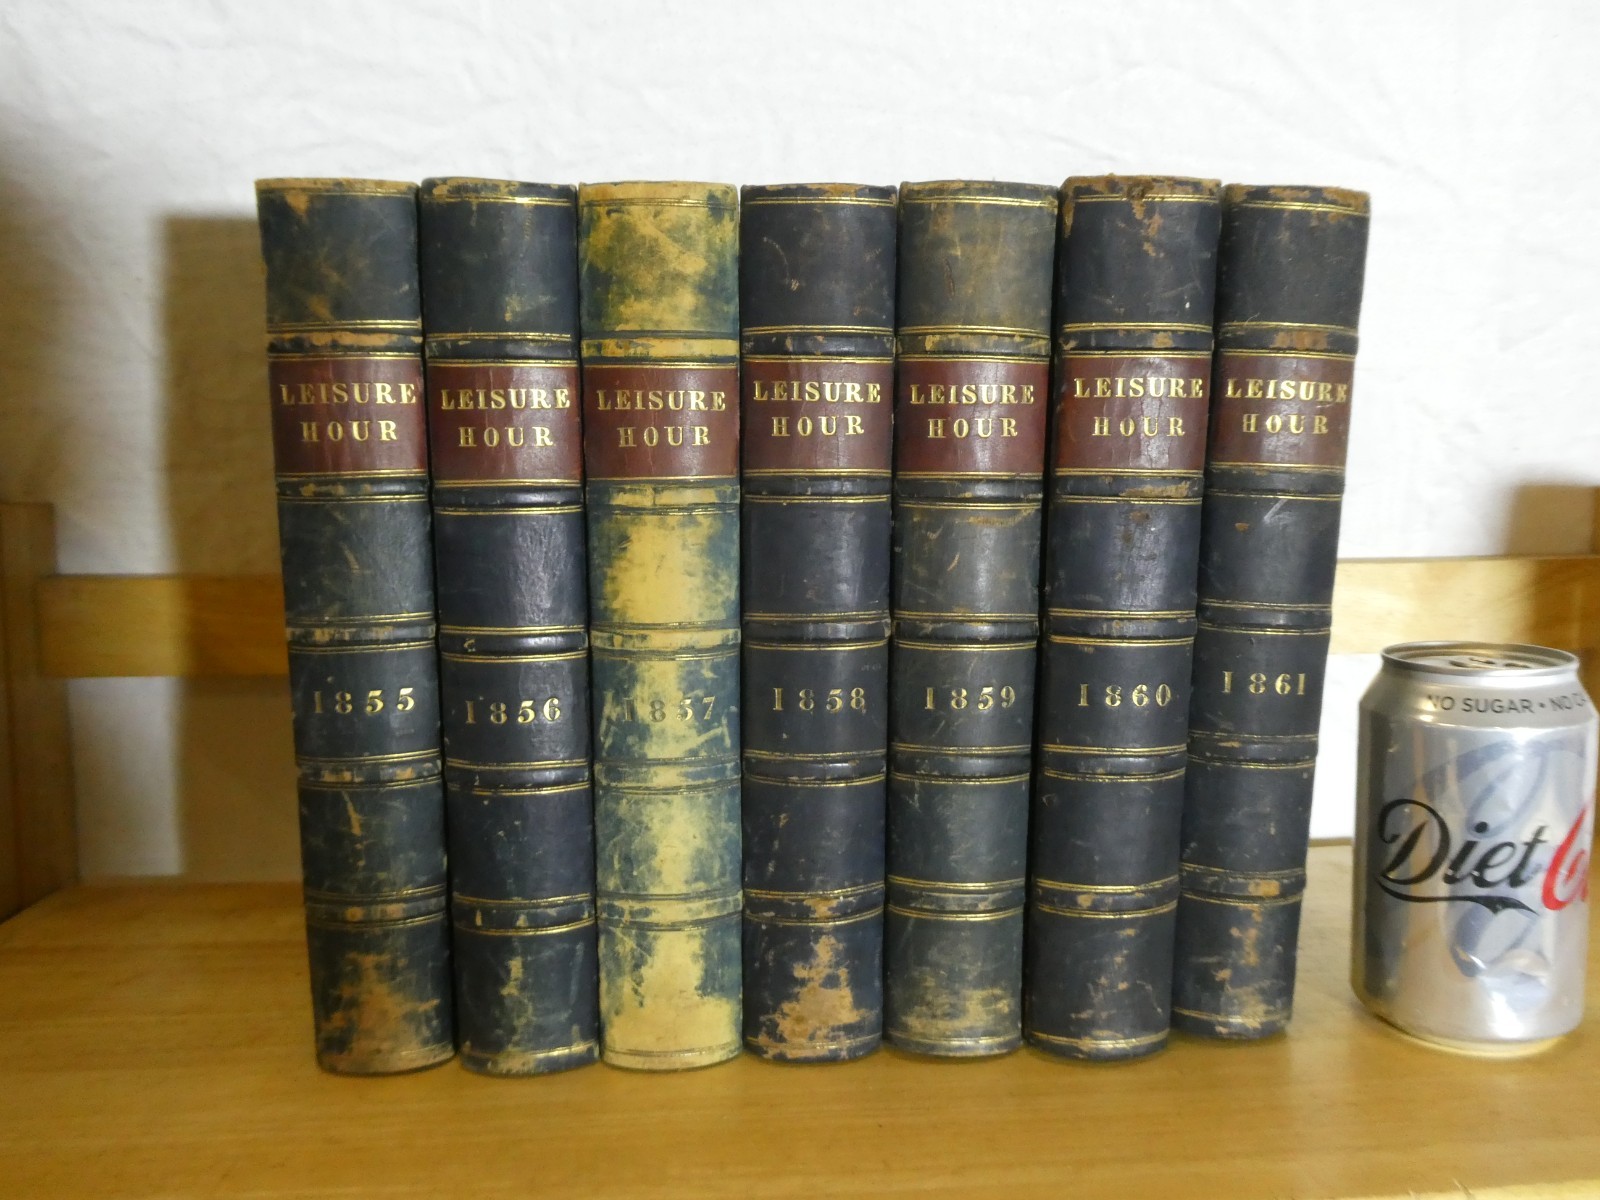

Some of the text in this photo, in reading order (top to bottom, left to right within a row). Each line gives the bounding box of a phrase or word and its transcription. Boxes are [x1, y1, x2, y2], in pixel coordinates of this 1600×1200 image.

[280, 382, 417, 405] LEISURE
[441, 387, 571, 410] LEISURE
[753, 380, 881, 403] LEISURE
[909, 383, 1034, 405] LEISURE
[1073, 377, 1203, 399] LEISURE
[1225, 378, 1350, 403] LEISURE
[596, 389, 726, 411] LEISURE
[300, 420, 398, 442] HOUR
[771, 415, 865, 437] HOUR
[927, 417, 1018, 439] HOUR
[1091, 416, 1186, 437] HOUR
[1242, 413, 1329, 435] HOUR
[458, 426, 556, 447] HOUR
[616, 426, 711, 447] HOUR
[1221, 670, 1306, 695] 1861
[313, 687, 415, 714] 1855
[773, 687, 866, 713] 1858
[924, 685, 1016, 710] 1859
[1078, 683, 1172, 707] 1860
[1460, 698, 1535, 714] SUGAR
[464, 698, 561, 724] 1856
[622, 696, 716, 722] 1857
[1377, 798, 1548, 889] Diet
